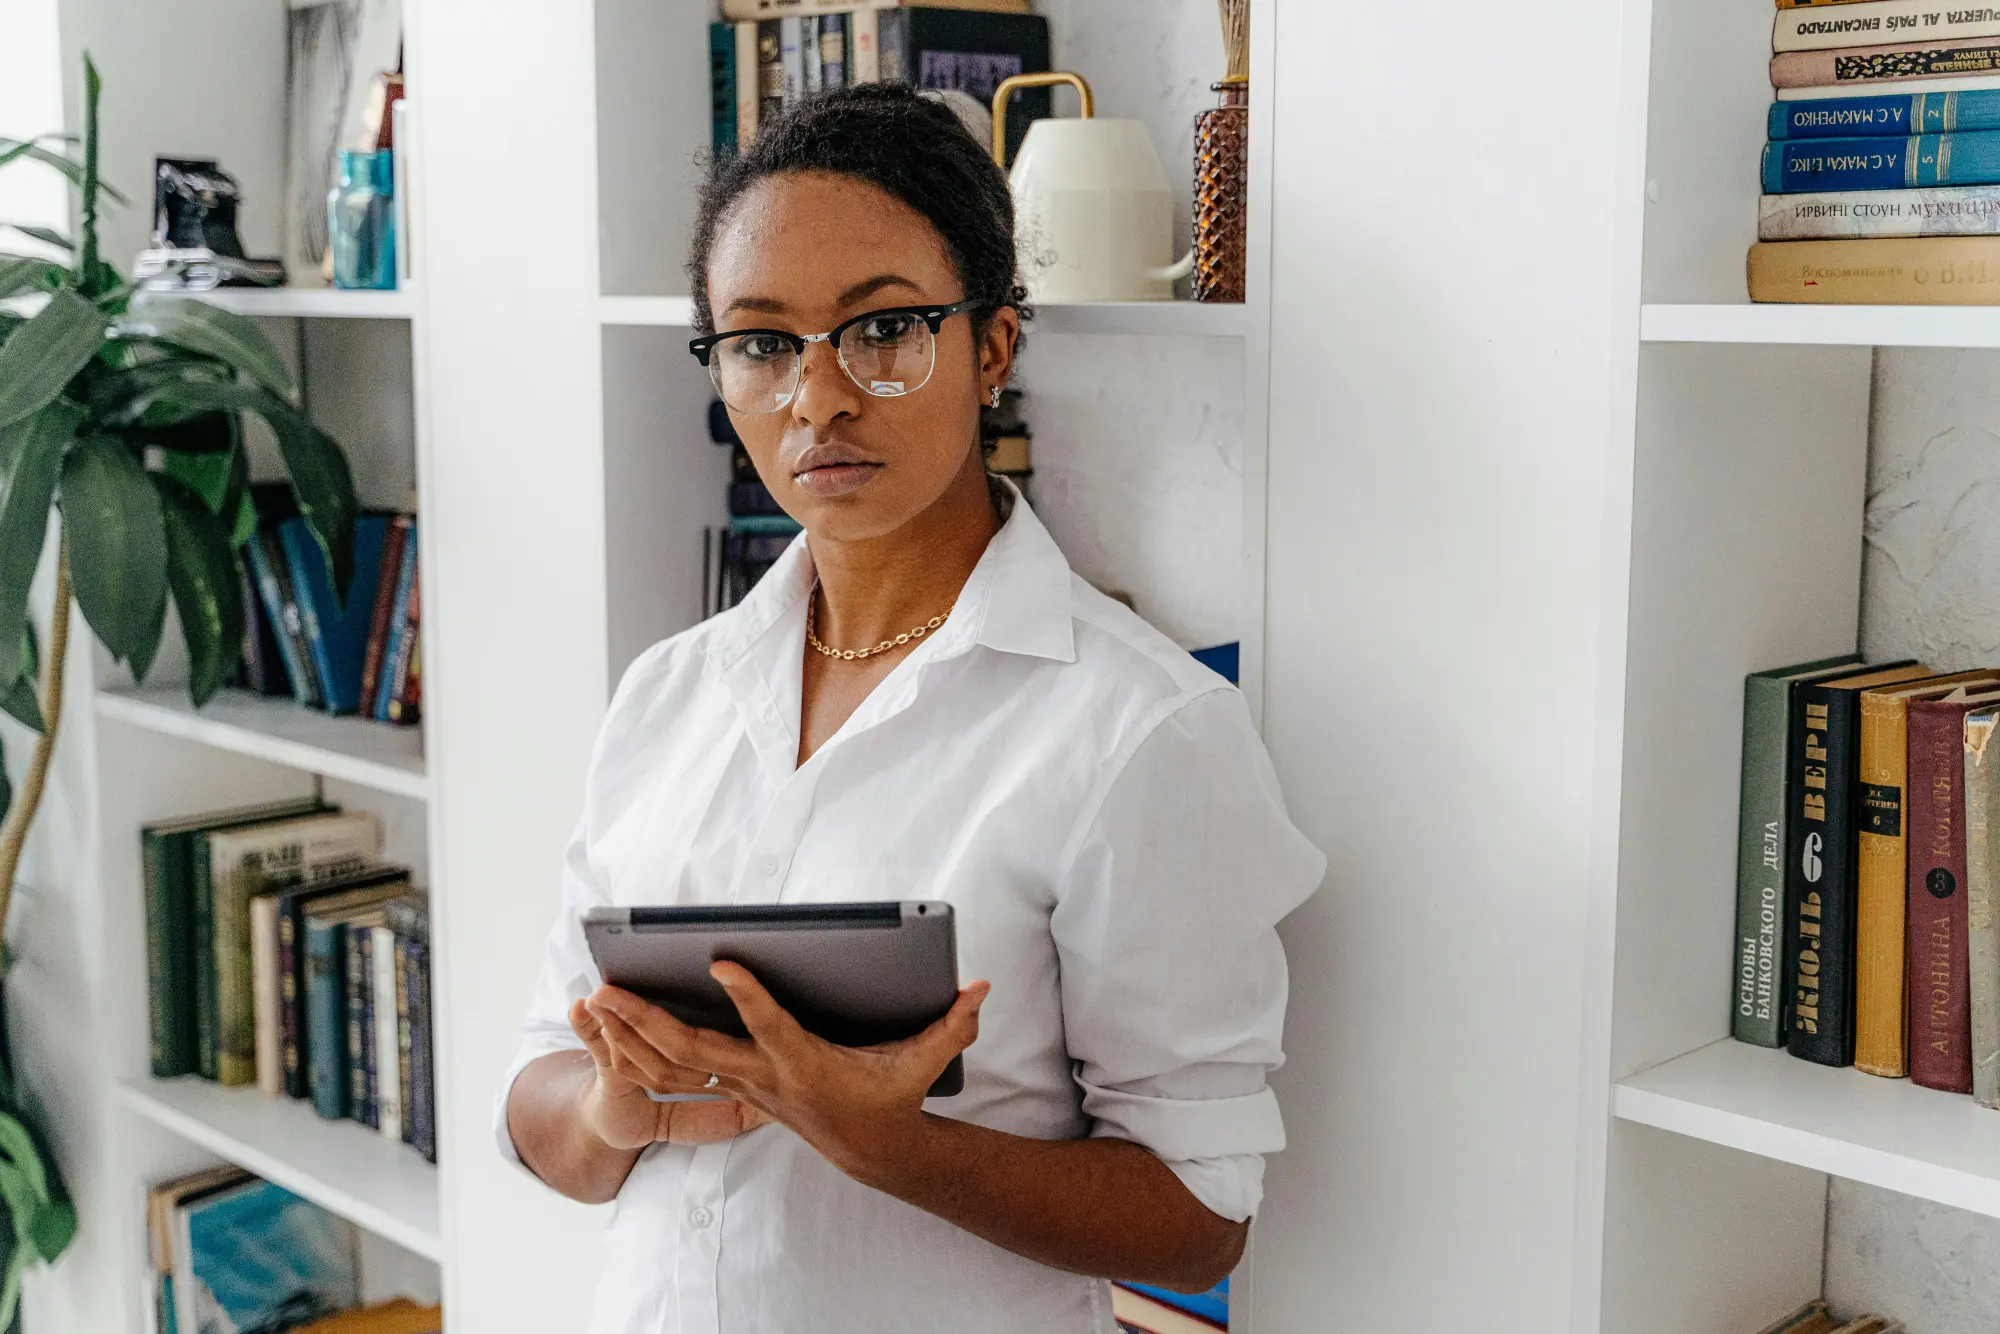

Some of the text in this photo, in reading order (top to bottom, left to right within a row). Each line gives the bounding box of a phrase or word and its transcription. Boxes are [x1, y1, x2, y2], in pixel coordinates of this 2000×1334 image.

[1797, 17, 1881, 35] ENCANTADO
[1886, 14, 1918, 32] PAÍS
[1922, 12, 1941, 26] AL
[1794, 109, 1874, 127] МАКАРЕНКО
[1928, 109, 1939, 118] 2
[1922, 156, 1933, 164] 5
[1796, 204, 1849, 218] ИРВИНГ
[1853, 204, 1900, 218] СТОУН
[1796, 703, 1829, 1035] ЖЮЛЬ 6 ВЕРН
[1757, 821, 1779, 1020] БАНКОВСКОГО ДЕЛА
[1740, 937, 1757, 1017] ОСНОВЫ
[1931, 916, 1951, 1056] АНТОНИНА
